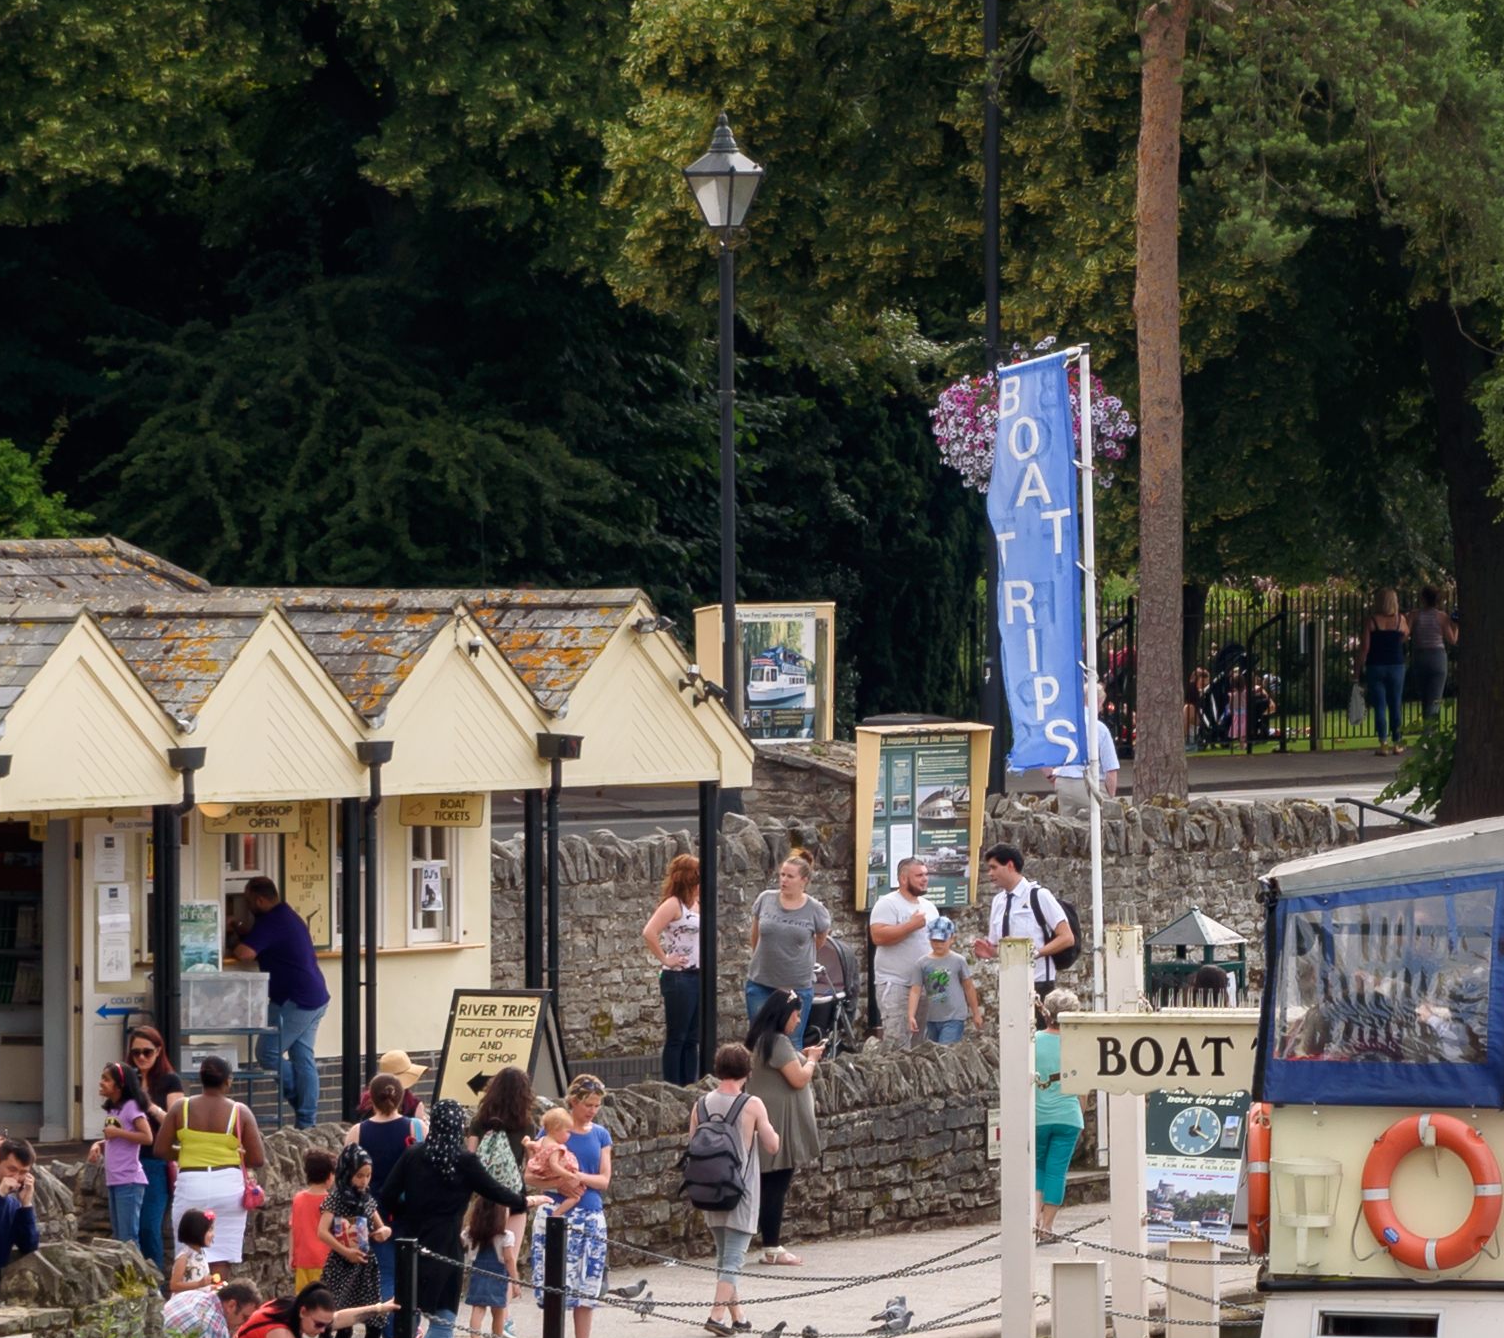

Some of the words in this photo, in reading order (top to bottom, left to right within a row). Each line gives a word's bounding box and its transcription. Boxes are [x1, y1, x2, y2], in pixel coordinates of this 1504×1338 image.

[998, 375, 1071, 555] BOAT
[997, 532, 1078, 765] TRIPS
[440, 799, 466, 809] BOAT
[236, 806, 261, 816] GIFT
[263, 806, 293, 816] SHOP
[434, 811, 470, 821] TICKETS
[248, 818, 280, 828] OPEN
[424, 869, 438, 879] DJ's
[458, 1004, 497, 1017] RIVER
[502, 1004, 536, 1017] TRIPS
[455, 1027, 492, 1037] TICKET
[495, 1028, 533, 1038] OFFICE
[479, 1041, 503, 1050] AND
[460, 1053, 484, 1062] GIFT
[487, 1053, 517, 1063] SHOP
[1096, 1036, 1235, 1077] BOAT
[1166, 1095, 1194, 1105] boat
[1195, 1096, 1216, 1106] trip
